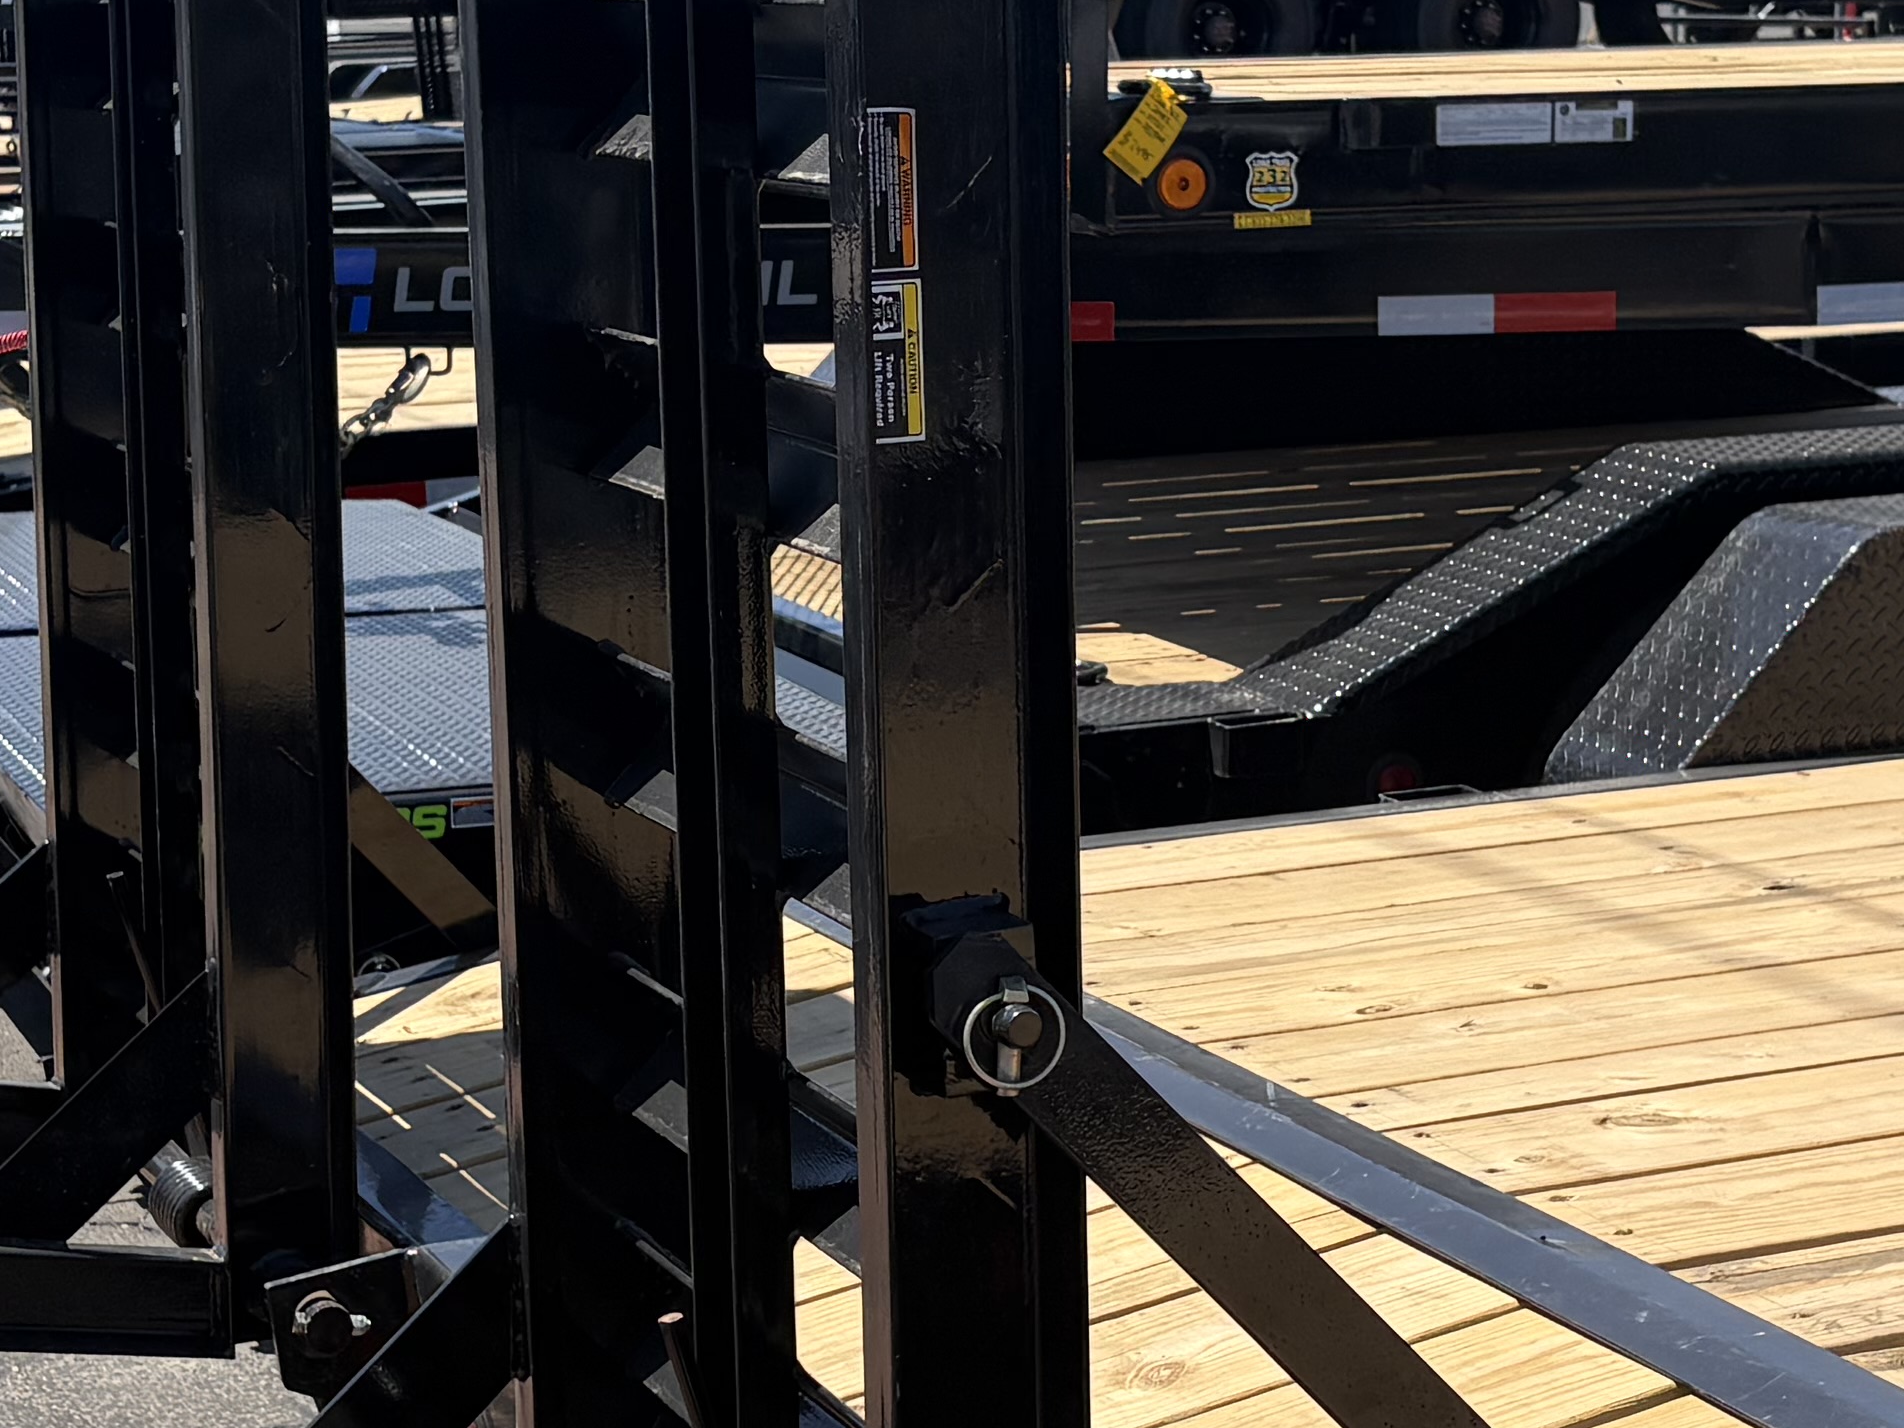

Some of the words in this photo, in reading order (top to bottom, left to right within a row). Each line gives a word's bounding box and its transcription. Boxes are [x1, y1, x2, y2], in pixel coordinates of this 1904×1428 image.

[1255, 168, 1288, 185] 232
[887, 353, 895, 379] Two
[908, 342, 917, 394] CAUTION
[886, 382, 895, 422] Person
